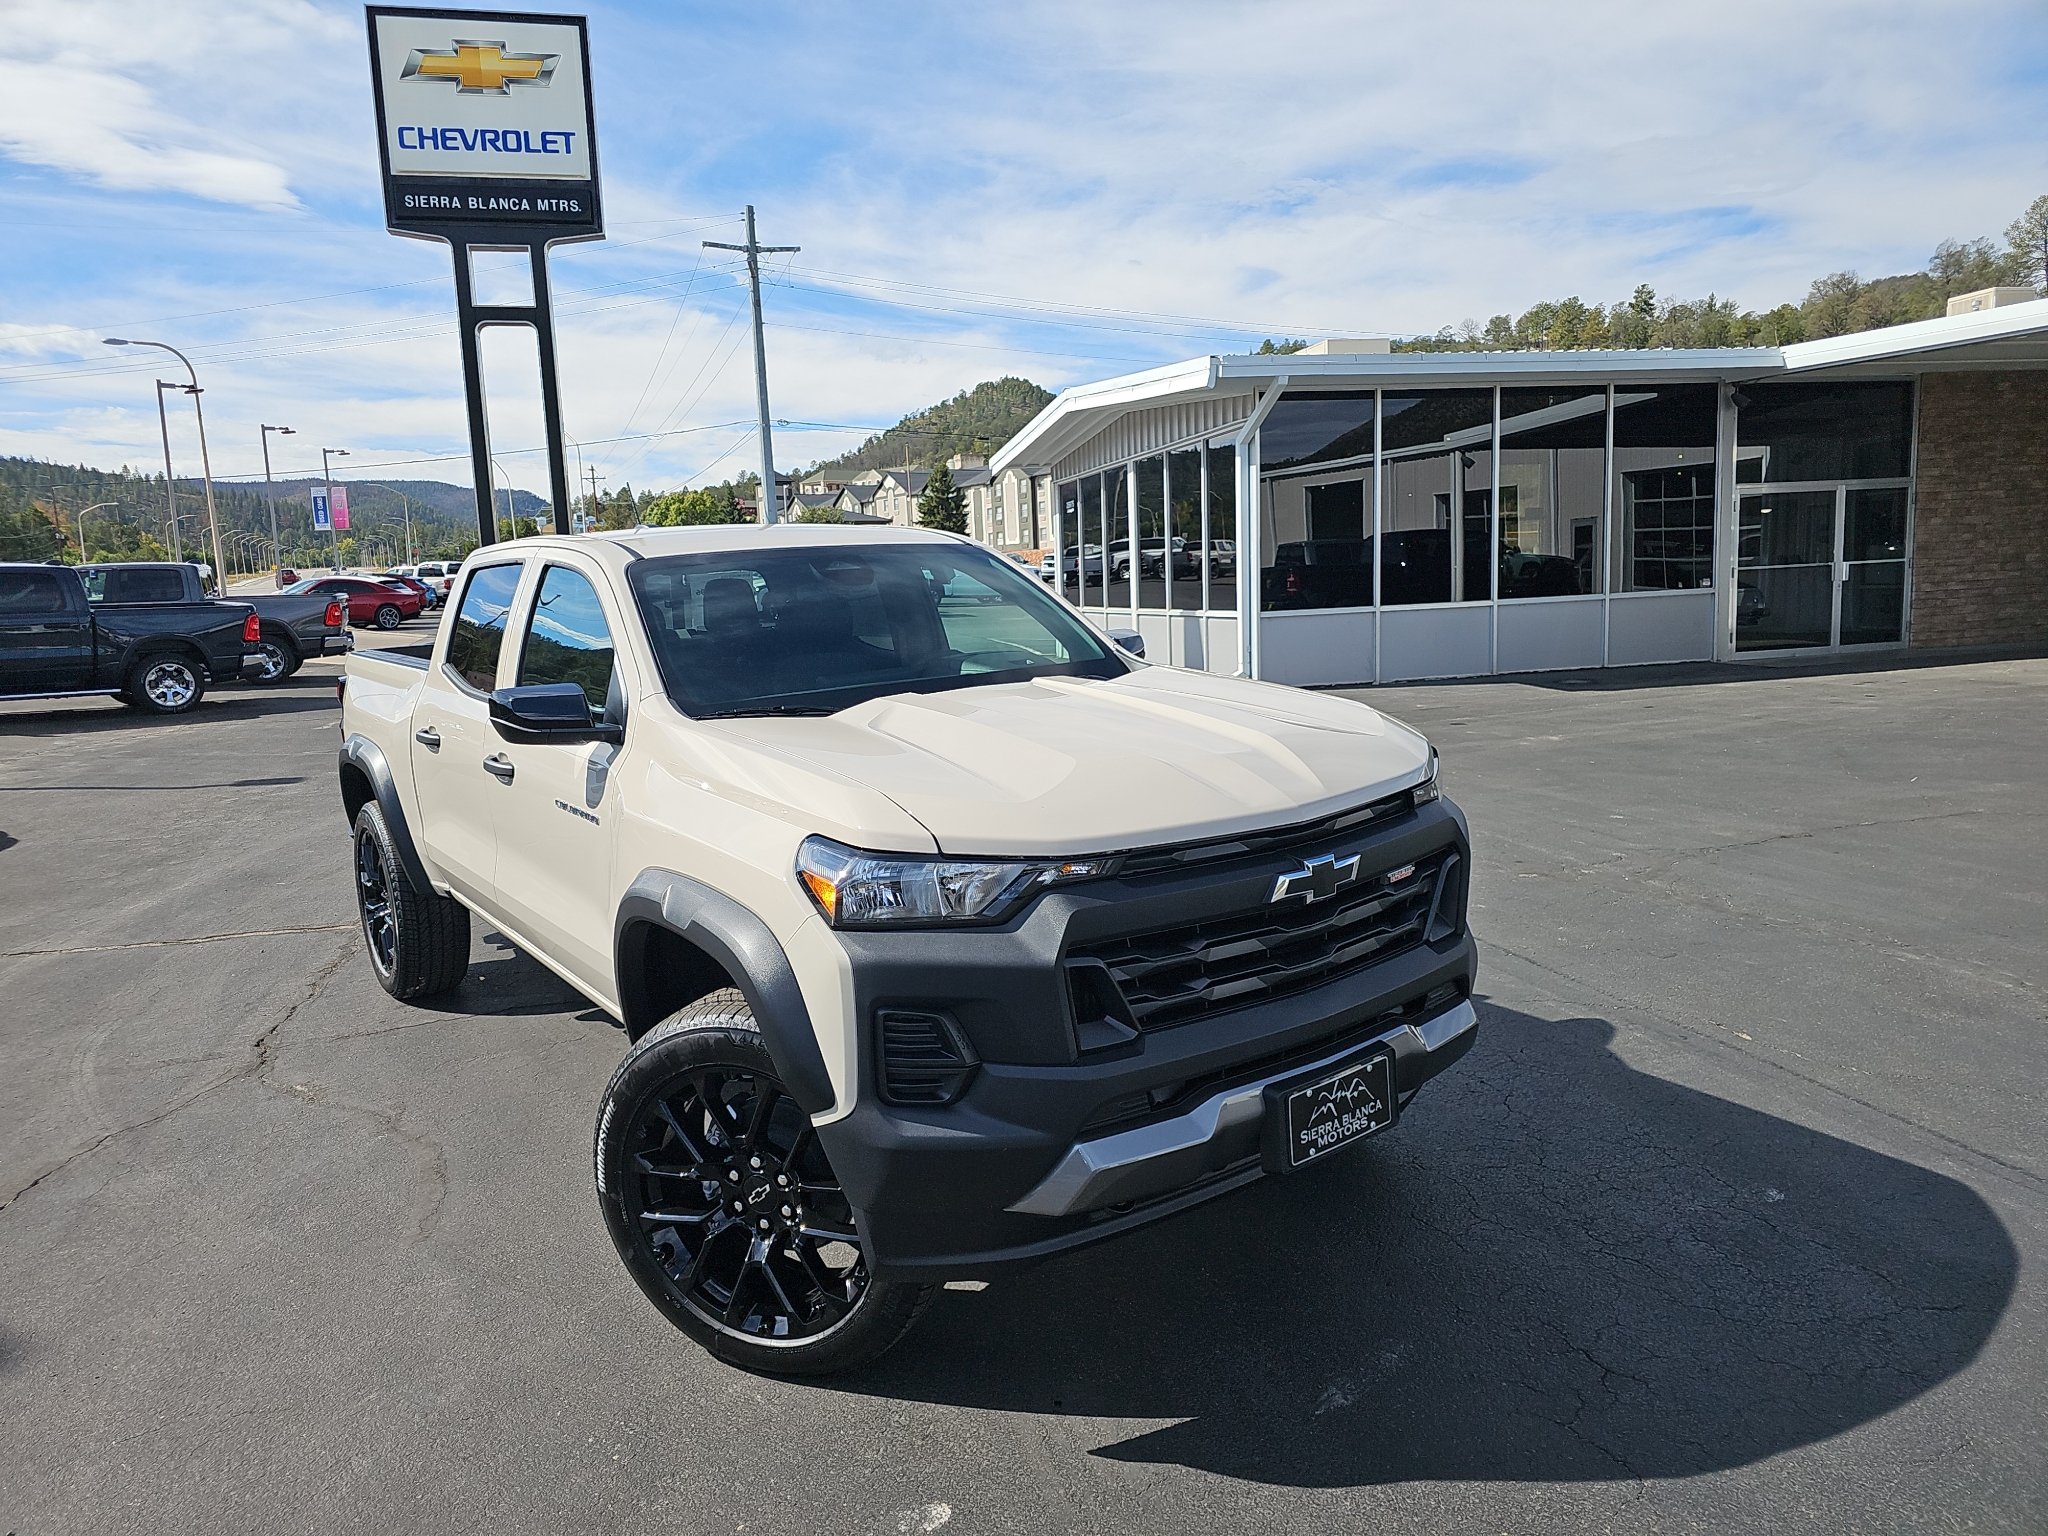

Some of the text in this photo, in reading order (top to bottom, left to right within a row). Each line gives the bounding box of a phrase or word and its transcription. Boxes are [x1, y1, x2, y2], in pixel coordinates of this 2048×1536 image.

[397, 126, 576, 155] CHEVROLET
[404, 194, 582, 213] SIERRA BLANCA MTRS.
[1300, 1099, 1382, 1144] SIERRA BLANCA
[1317, 1117, 1369, 1147] MOTORS
[597, 1097, 617, 1194] BRIDGESTONE
